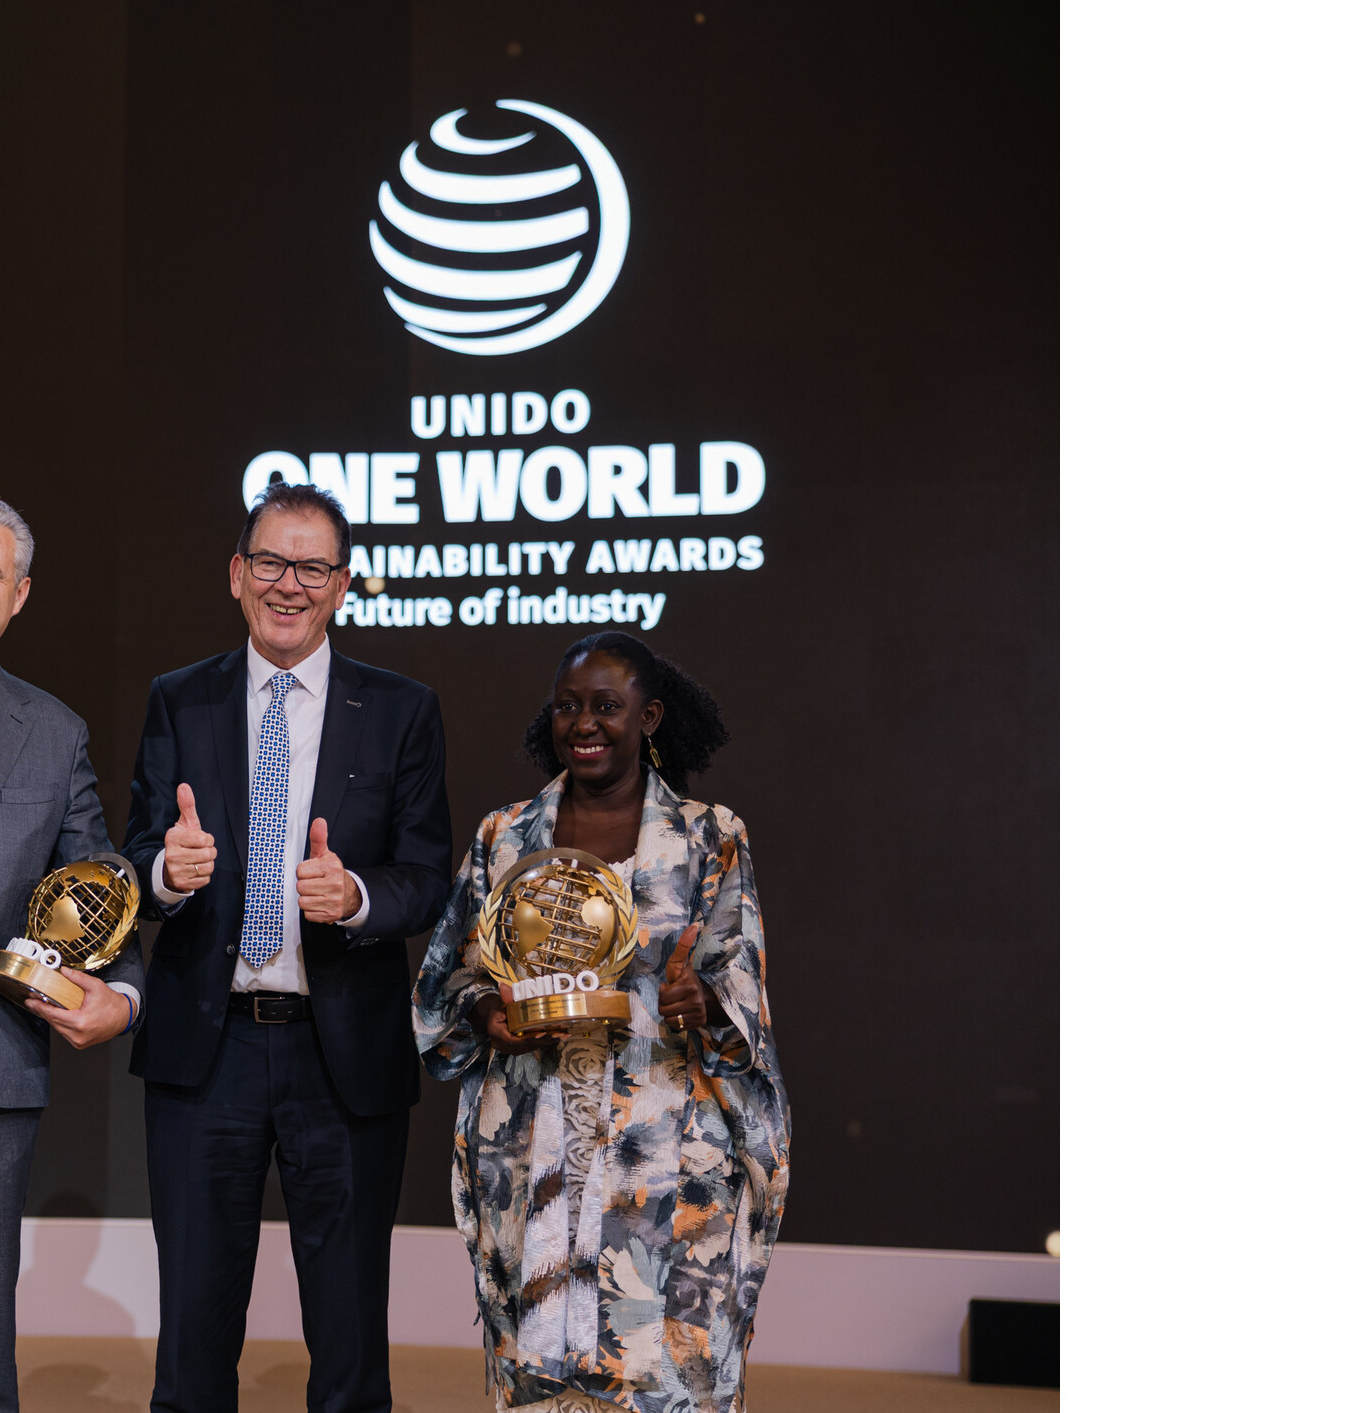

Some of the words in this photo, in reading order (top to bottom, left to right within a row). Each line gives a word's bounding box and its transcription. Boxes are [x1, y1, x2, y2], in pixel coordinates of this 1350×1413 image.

[411, 389, 591, 439] UNIDO
[436, 441, 766, 523] WORLD
[349, 543, 576, 577] AINABILITY
[586, 536, 765, 574] AWARDS
[335, 592, 453, 627] Future
[459, 588, 504, 626] of
[507, 585, 666, 631] industry
